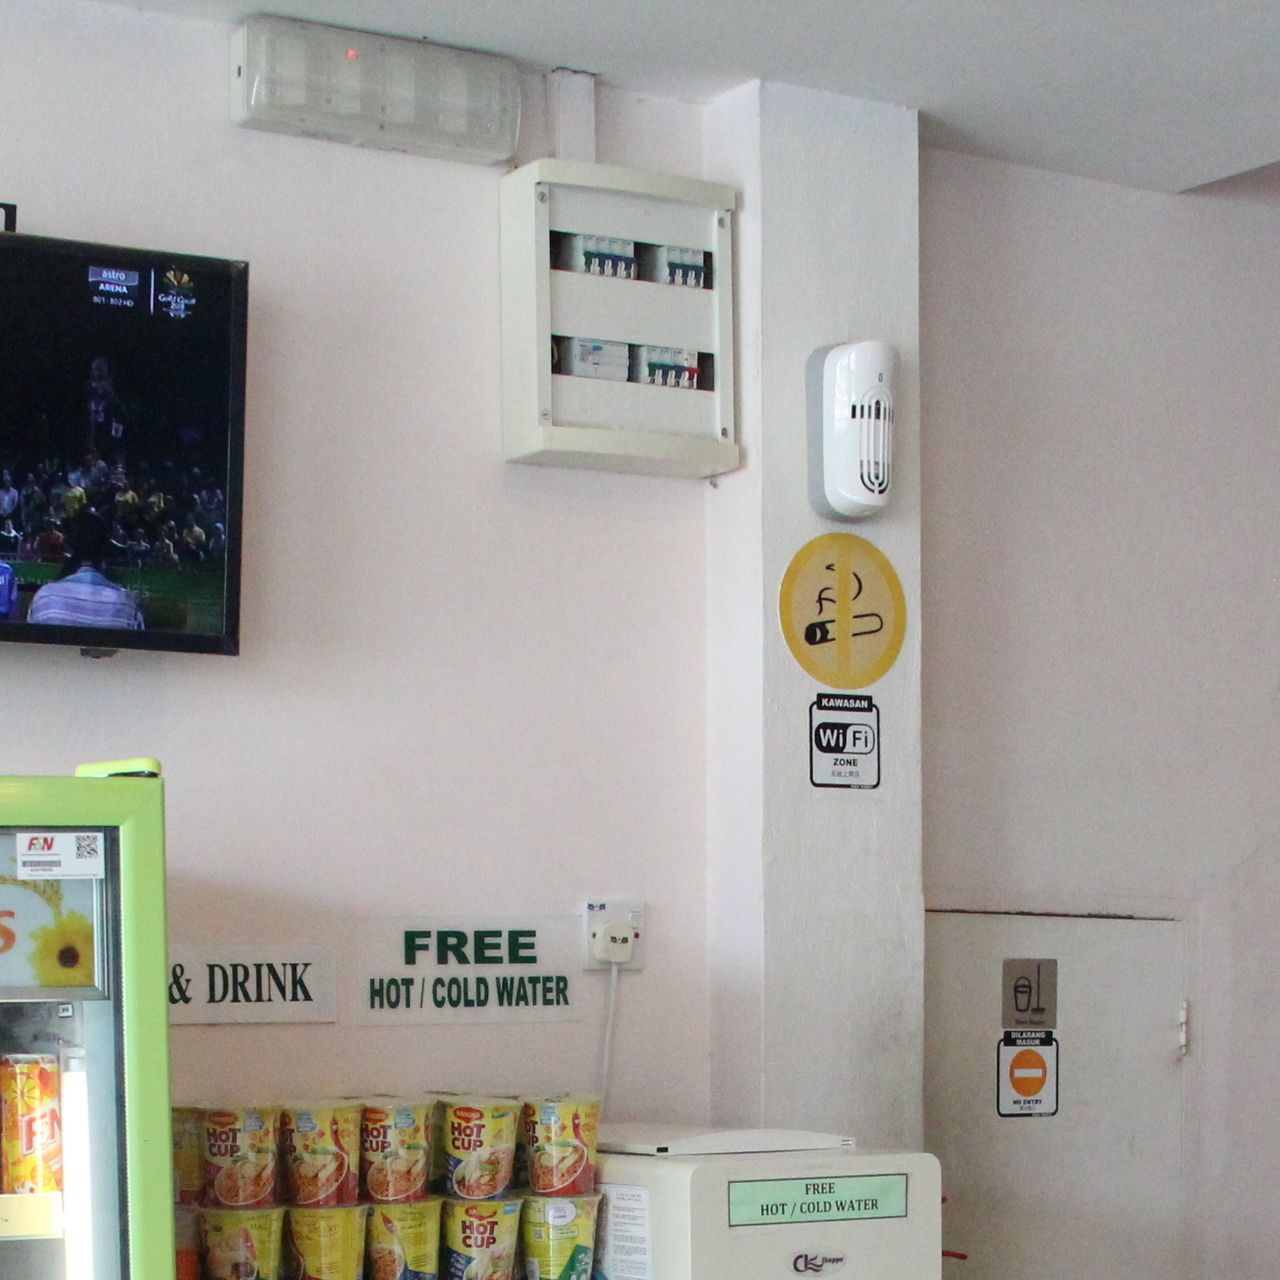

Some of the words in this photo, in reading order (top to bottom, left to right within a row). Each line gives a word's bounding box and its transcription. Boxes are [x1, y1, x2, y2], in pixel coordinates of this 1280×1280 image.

[101, 269, 126, 281] astro
[99, 284, 128, 294] ARENA
[821, 697, 869, 709] KAWASAN
[833, 757, 858, 767] ZONE
[404, 929, 538, 965] FREE
[168, 963, 192, 1004] &
[207, 962, 314, 1004] DRINK
[369, 977, 415, 1009] HOT
[432, 976, 489, 1008] COLD
[496, 975, 570, 1008] WATER
[1011, 1031, 1046, 1039] DILARANG
[207, 1128, 241, 1143] HOT
[451, 1122, 486, 1138] HOT
[208, 1143, 241, 1157] CUP
[452, 1138, 484, 1151] CUP
[805, 1182, 836, 1195] FREE
[760, 1203, 787, 1216] HOT
[800, 1201, 832, 1214] COLD
[835, 1198, 879, 1212] WATER
[461, 1220, 498, 1235] HOT
[462, 1234, 497, 1249] CUP
